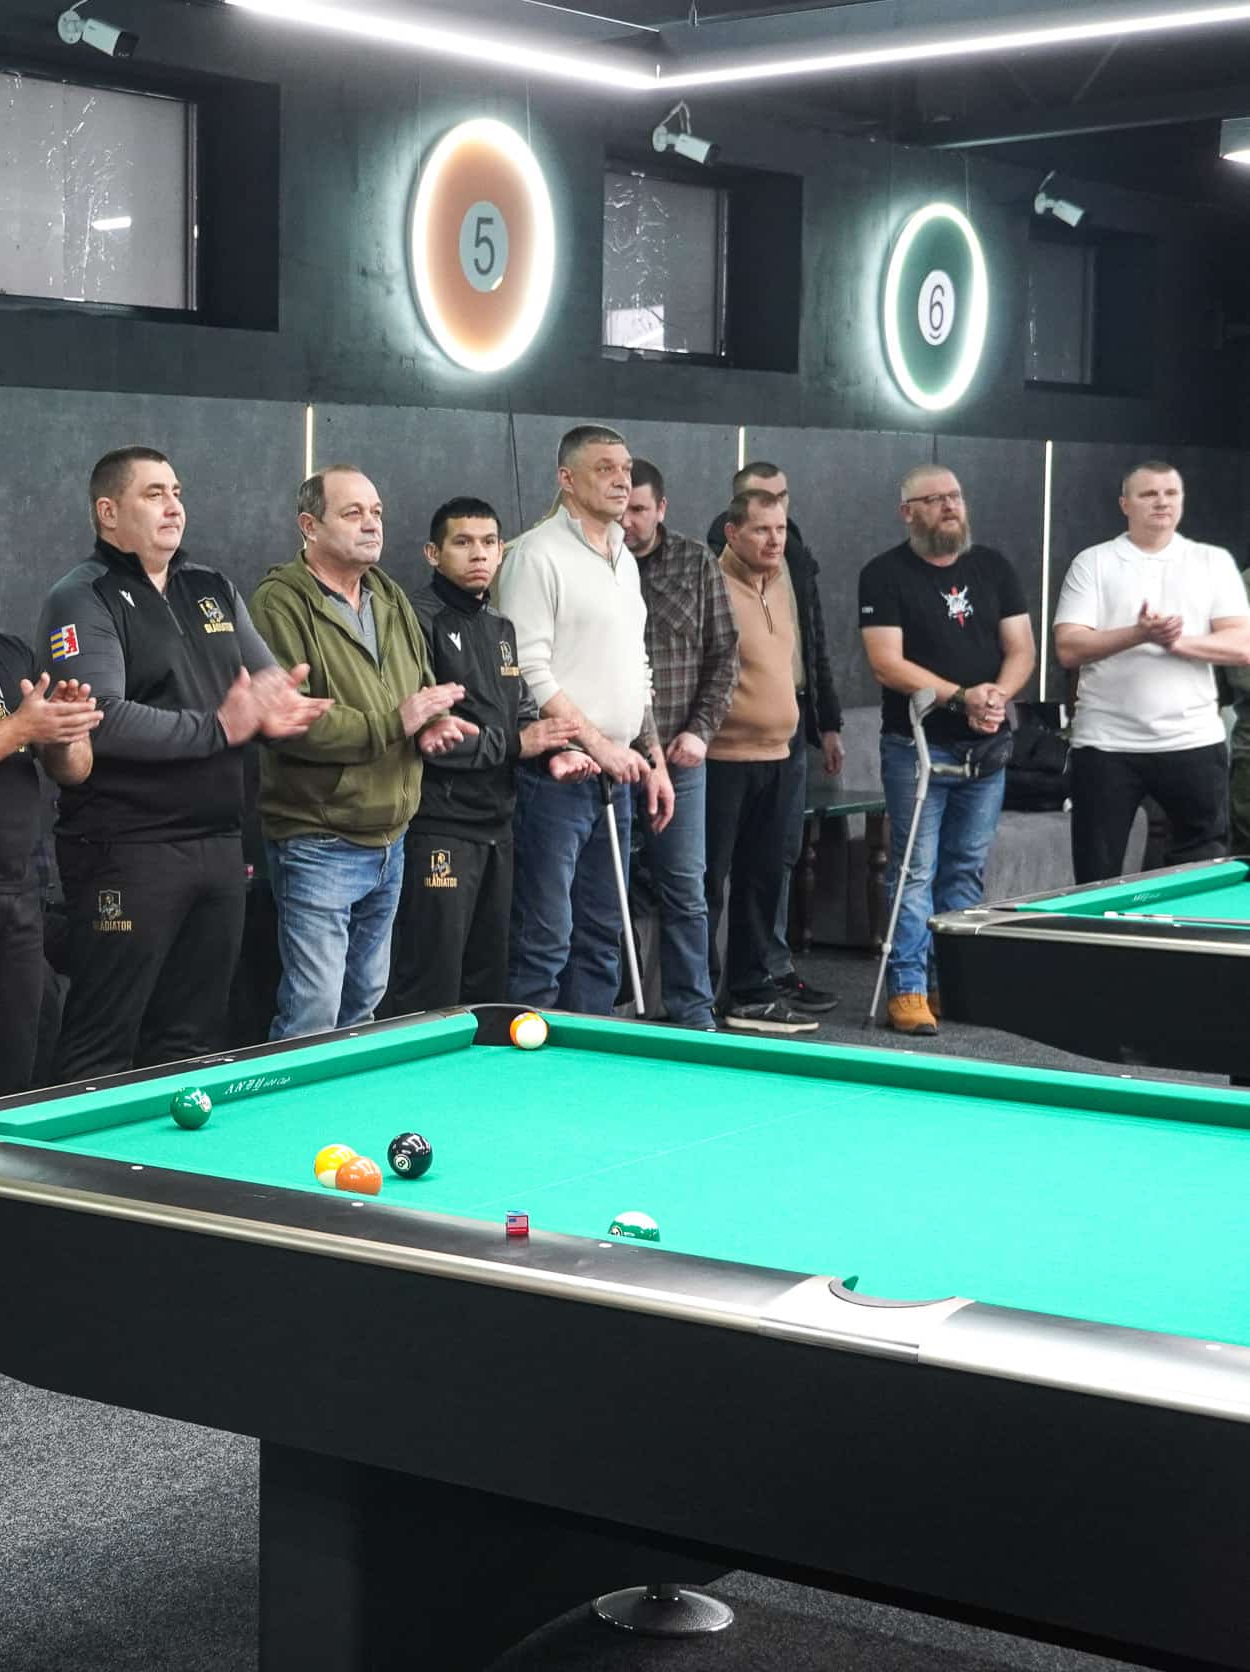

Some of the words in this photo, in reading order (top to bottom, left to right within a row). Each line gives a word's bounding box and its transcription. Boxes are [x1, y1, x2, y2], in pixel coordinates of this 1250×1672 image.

[473, 216, 495, 276] 5
[928, 284, 945, 332] 6
[396, 1159, 407, 1169] 8
